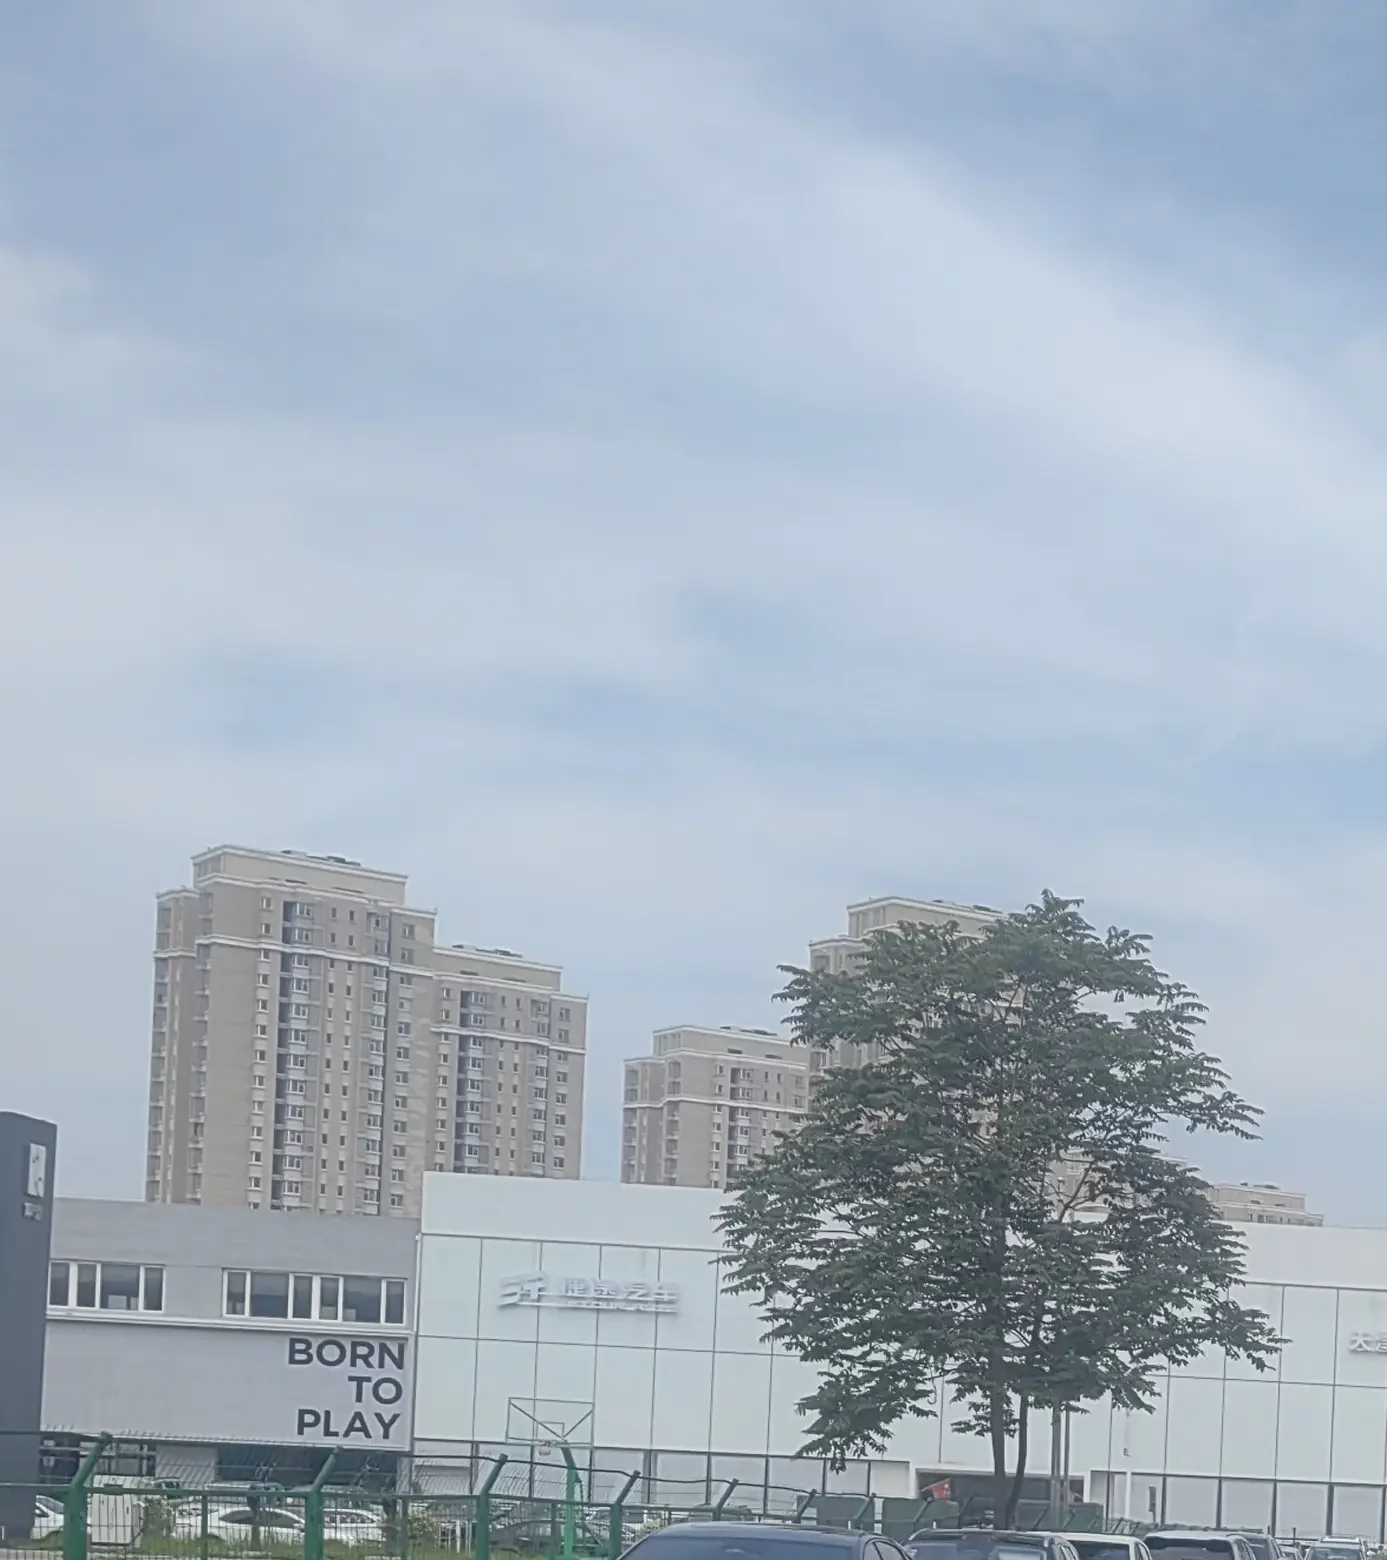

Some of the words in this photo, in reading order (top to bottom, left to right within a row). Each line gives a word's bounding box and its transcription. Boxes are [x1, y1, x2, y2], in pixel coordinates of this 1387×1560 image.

[288, 1337, 405, 1370] BORN
[347, 1375, 403, 1405] TO
[297, 1408, 402, 1440] PLAY
